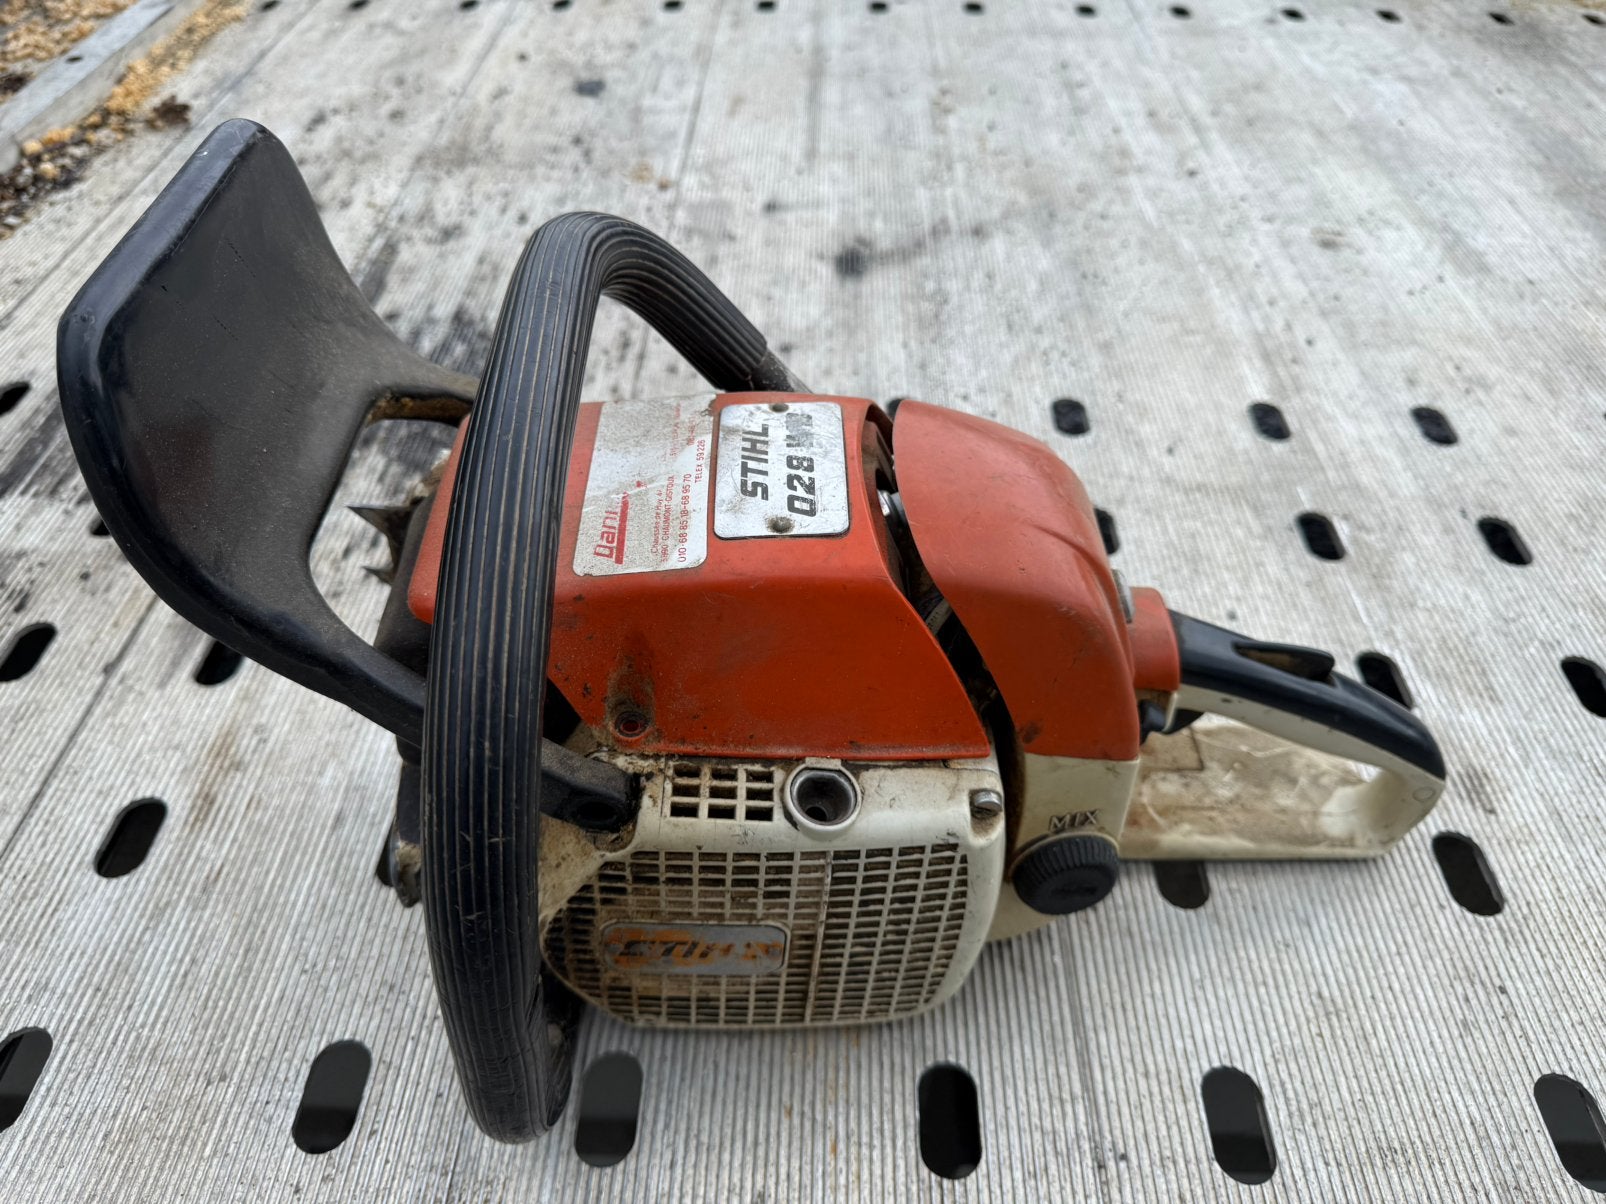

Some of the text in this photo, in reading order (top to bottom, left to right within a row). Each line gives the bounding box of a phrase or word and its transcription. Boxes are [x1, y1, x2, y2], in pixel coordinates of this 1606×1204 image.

[694, 464, 703, 483] TELEX
[740, 424, 768, 501] STIHL
[683, 474, 692, 483] 70
[786, 455, 816, 517] 028
[1048, 808, 1099, 831] MIX
